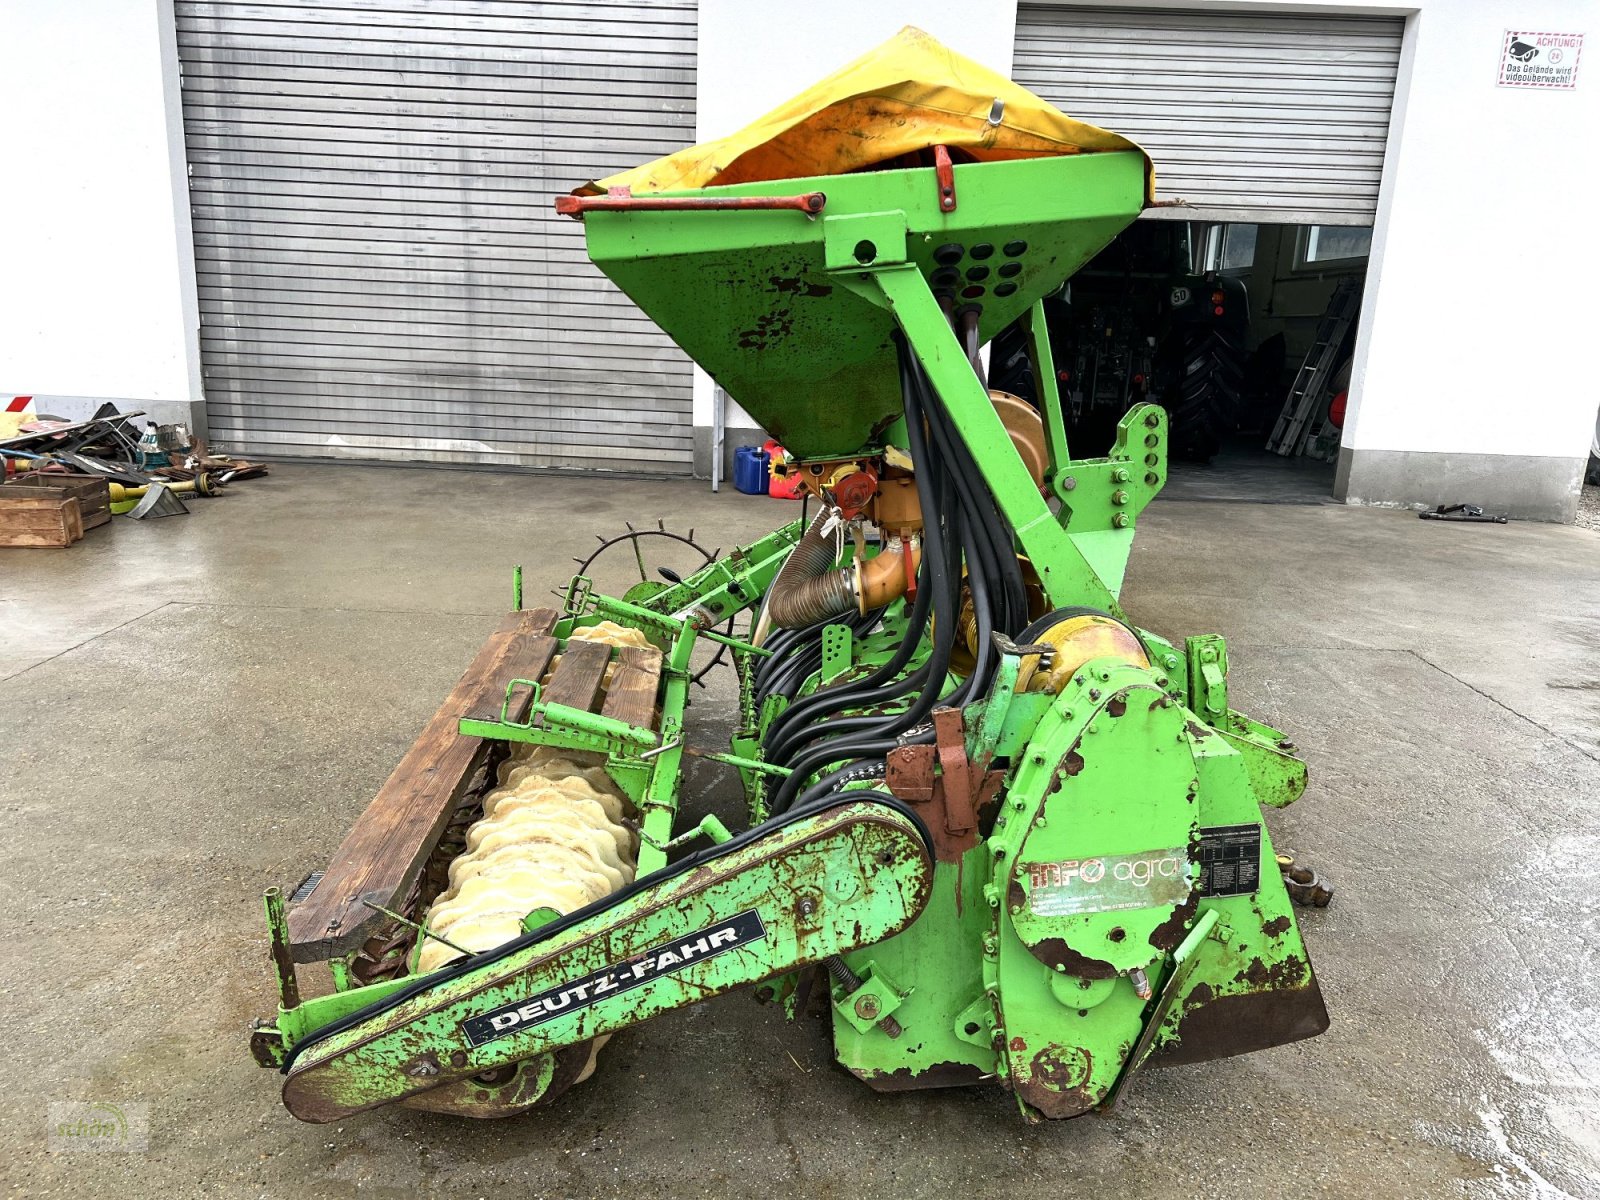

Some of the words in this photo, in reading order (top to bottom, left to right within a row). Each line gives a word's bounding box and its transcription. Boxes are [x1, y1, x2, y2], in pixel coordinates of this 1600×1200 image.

[1536, 37, 1580, 48] ACHTUNG!
[1506, 63, 1521, 73] Das
[1523, 64, 1554, 75] Gelände
[1555, 66, 1573, 75] wird
[1505, 72, 1571, 84] videoüberwacht!
[1174, 289, 1186, 303] 50
[490, 926, 739, 1031] DEUTZ-FAHR
